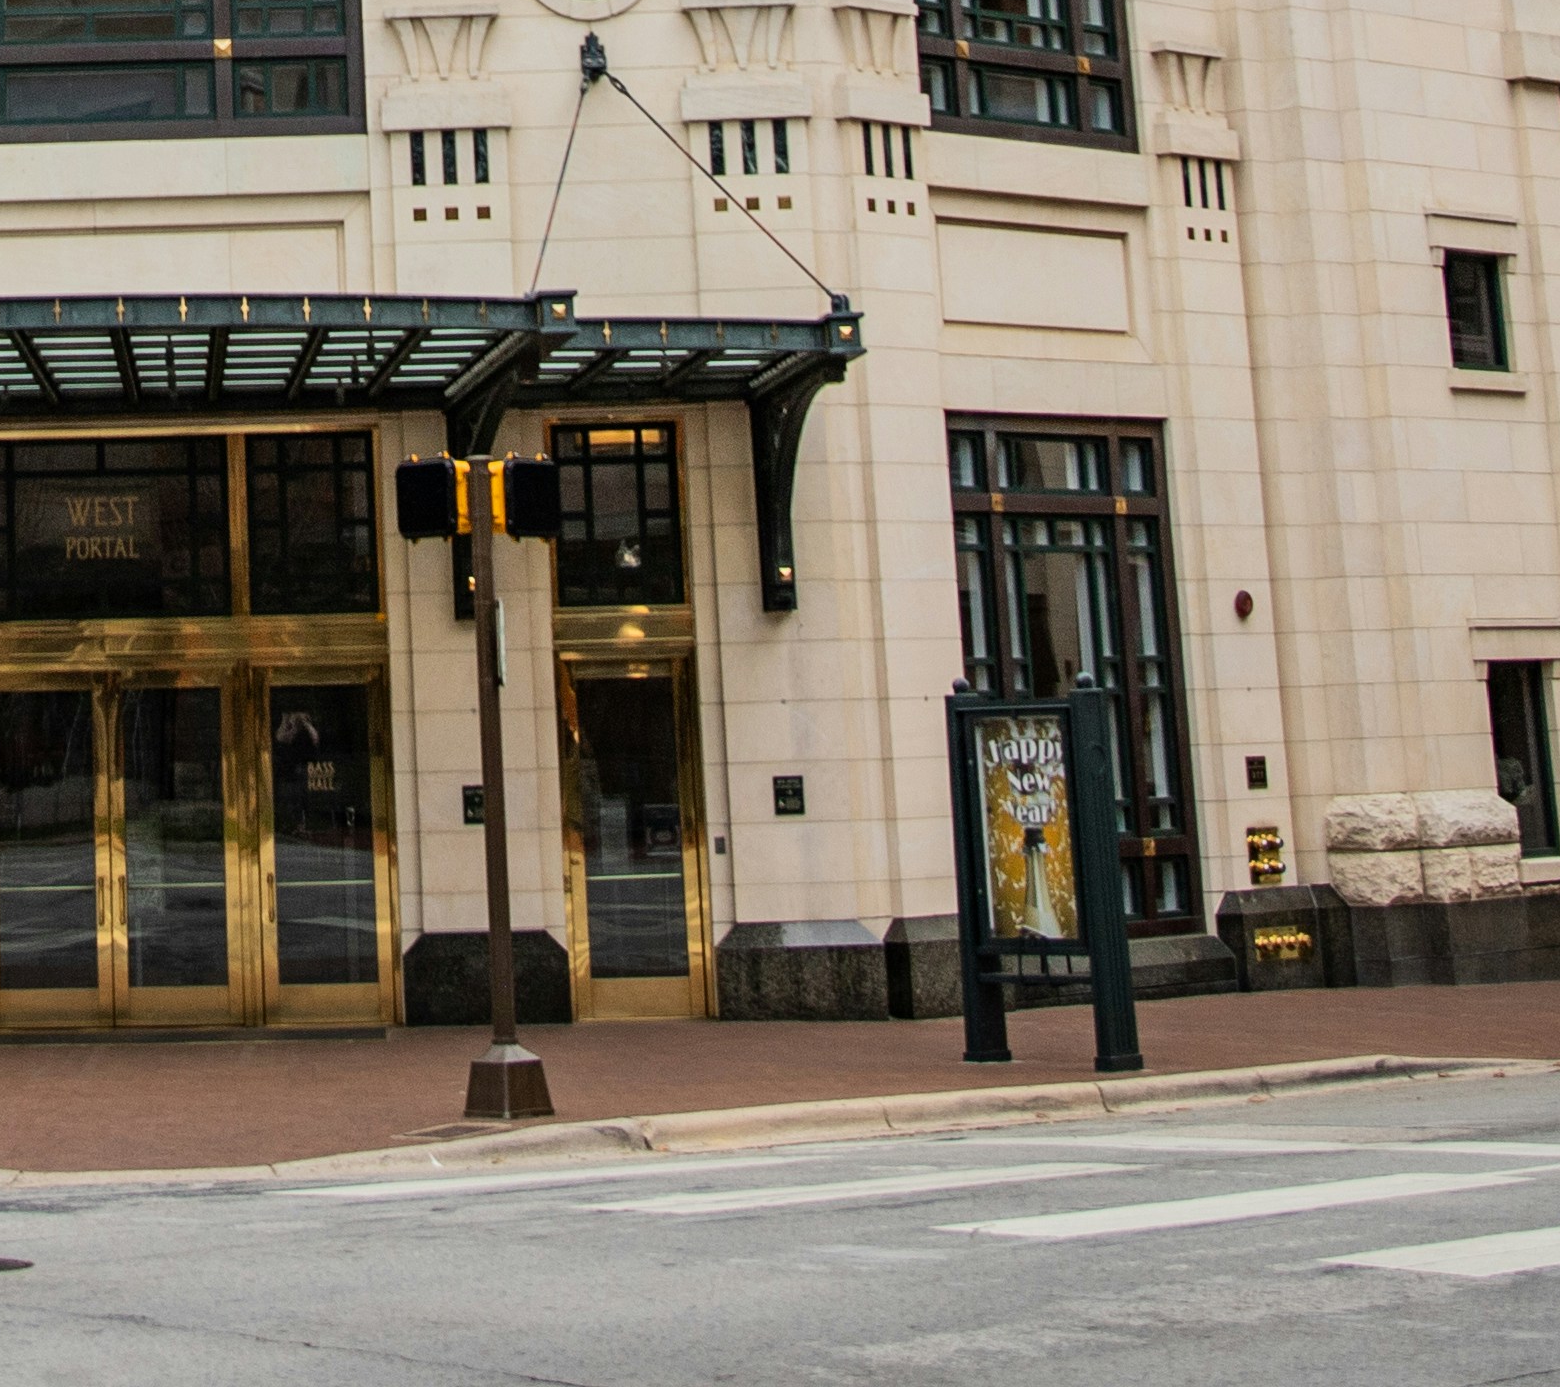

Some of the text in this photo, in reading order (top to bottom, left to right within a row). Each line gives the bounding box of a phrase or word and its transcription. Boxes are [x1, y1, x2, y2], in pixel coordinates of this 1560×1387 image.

[65, 495, 139, 526] WEST
[65, 536, 139, 561] PORTAL
[307, 761, 335, 774] BASS
[307, 778, 335, 791] HALL
[1006, 769, 1051, 793] New
